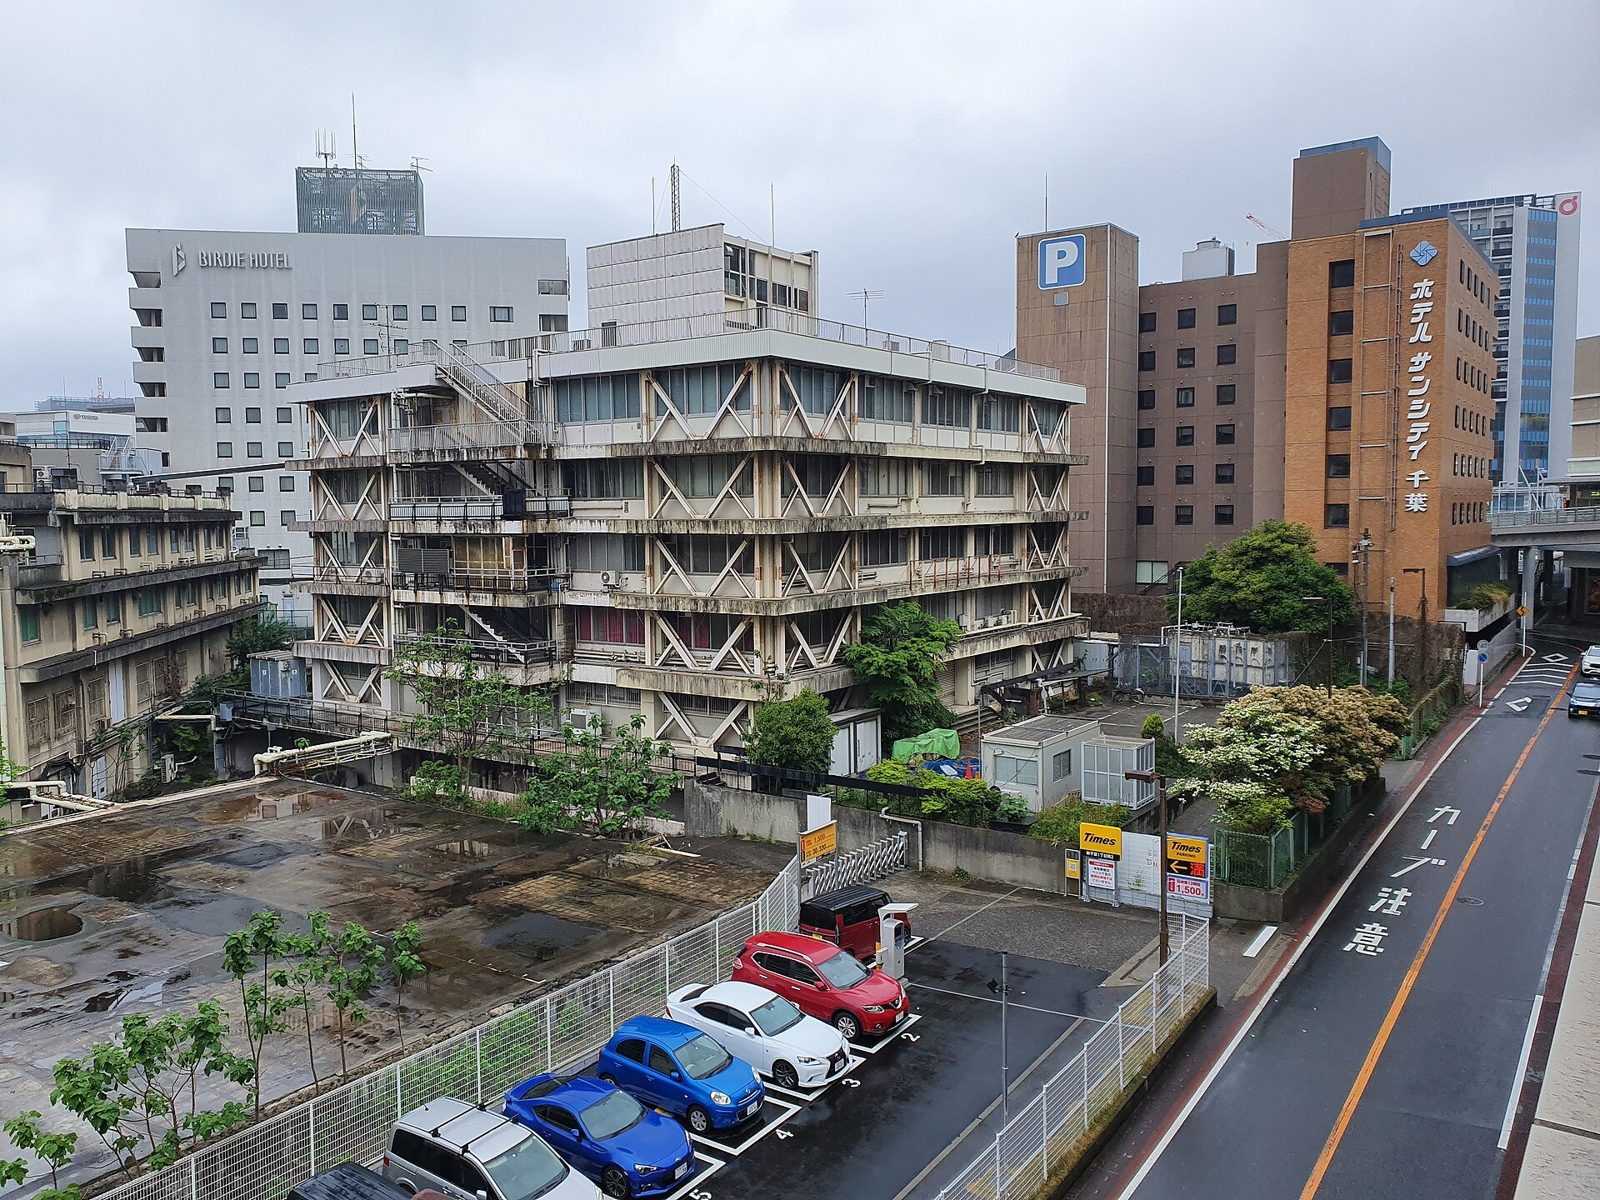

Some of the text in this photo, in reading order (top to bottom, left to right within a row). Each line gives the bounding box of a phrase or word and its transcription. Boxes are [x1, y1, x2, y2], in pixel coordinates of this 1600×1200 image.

[199, 250, 293, 270] BIRDIE HOTEL
[1045, 241, 1079, 285] P
[1405, 278, 1435, 513] ホテル サンシティ 千葉
[1083, 832, 1117, 846] Times
[1171, 841, 1202, 854] Times
[1189, 862, 1205, 878] 満
[1343, 805, 1462, 956] カーブ注意
[901, 1033, 921, 1042] 2
[842, 1078, 861, 1088] 3
[776, 1129, 794, 1141] 4
[689, 1189, 712, 1200] 5
